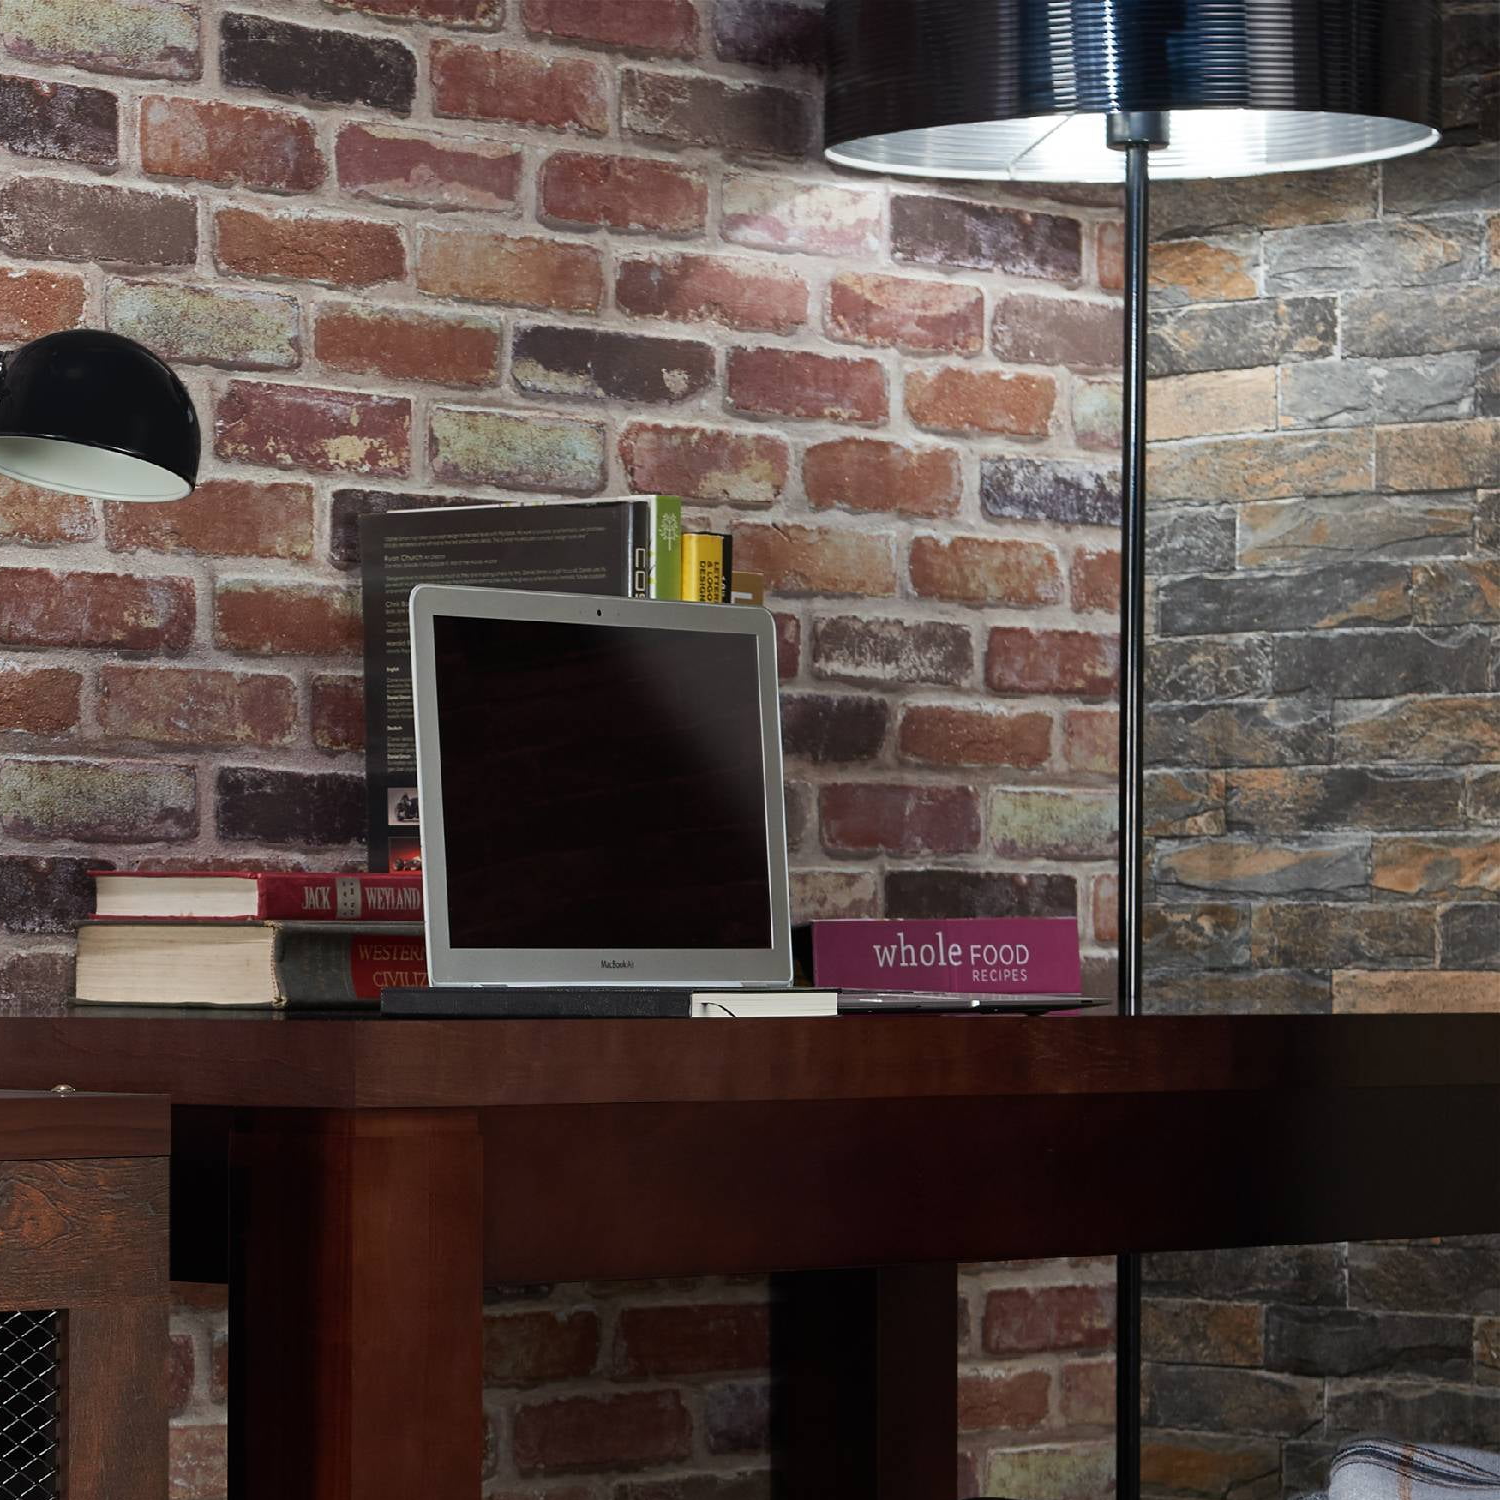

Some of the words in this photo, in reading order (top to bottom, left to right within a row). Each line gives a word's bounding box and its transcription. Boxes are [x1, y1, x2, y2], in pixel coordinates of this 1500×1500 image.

[301, 886, 332, 910] JACK
[364, 886, 421, 910] WEYLAND
[358, 943, 426, 961] WESTER
[873, 931, 963, 968] whole
[970, 944, 1030, 966] FOOD
[972, 968, 1028, 982] RECIPES
